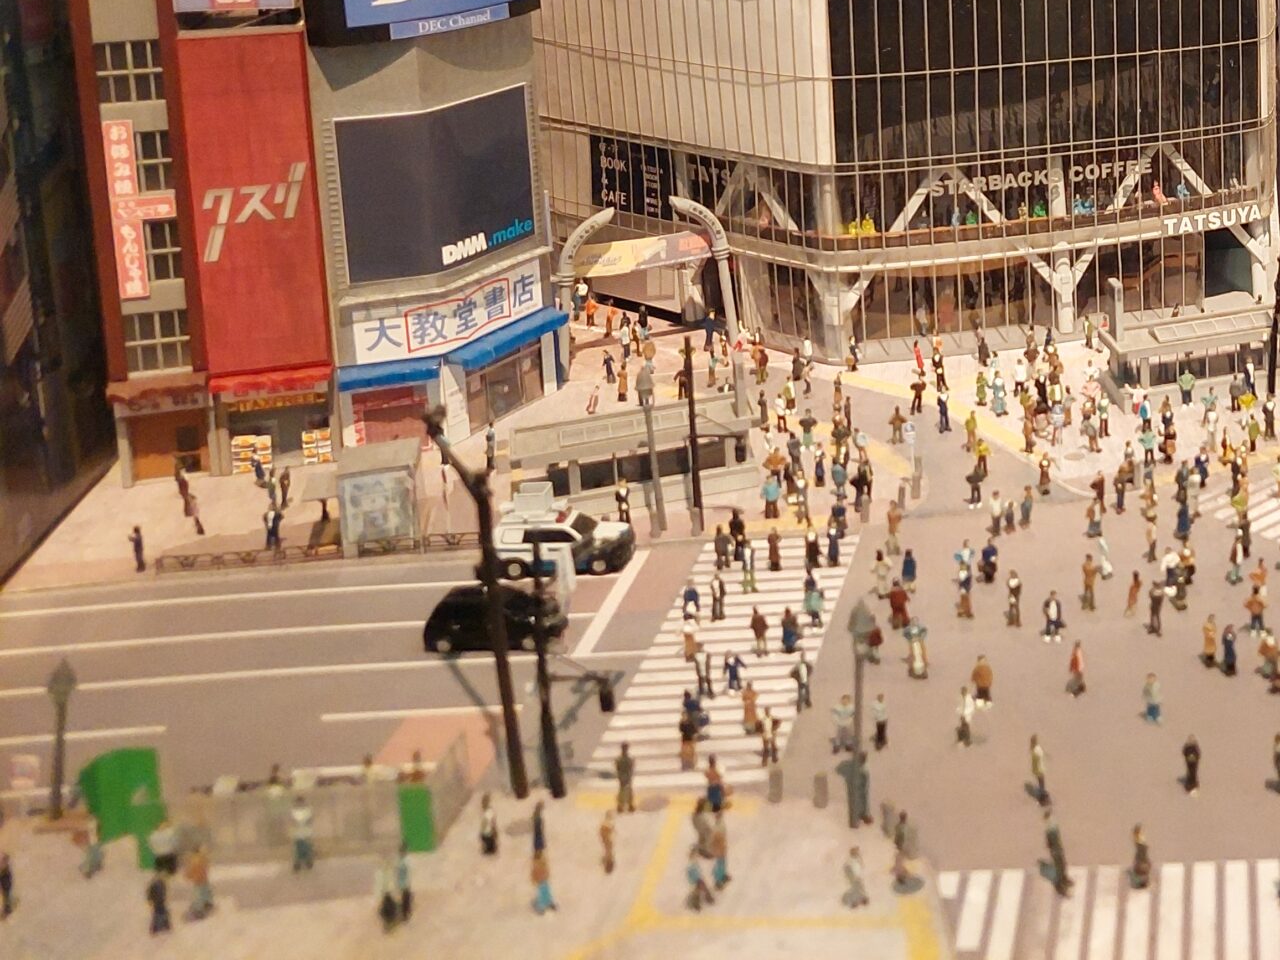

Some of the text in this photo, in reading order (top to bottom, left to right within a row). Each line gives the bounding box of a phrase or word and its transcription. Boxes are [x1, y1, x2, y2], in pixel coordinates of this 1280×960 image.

[418, 10, 491, 33] DEC Channel
[600, 155, 627, 172] BOOK
[1069, 158, 1152, 182] COFFEE
[601, 189, 627, 205] CAFE
[1164, 204, 1262, 236] TATSUYA
[364, 273, 535, 352] 大教堂書店
